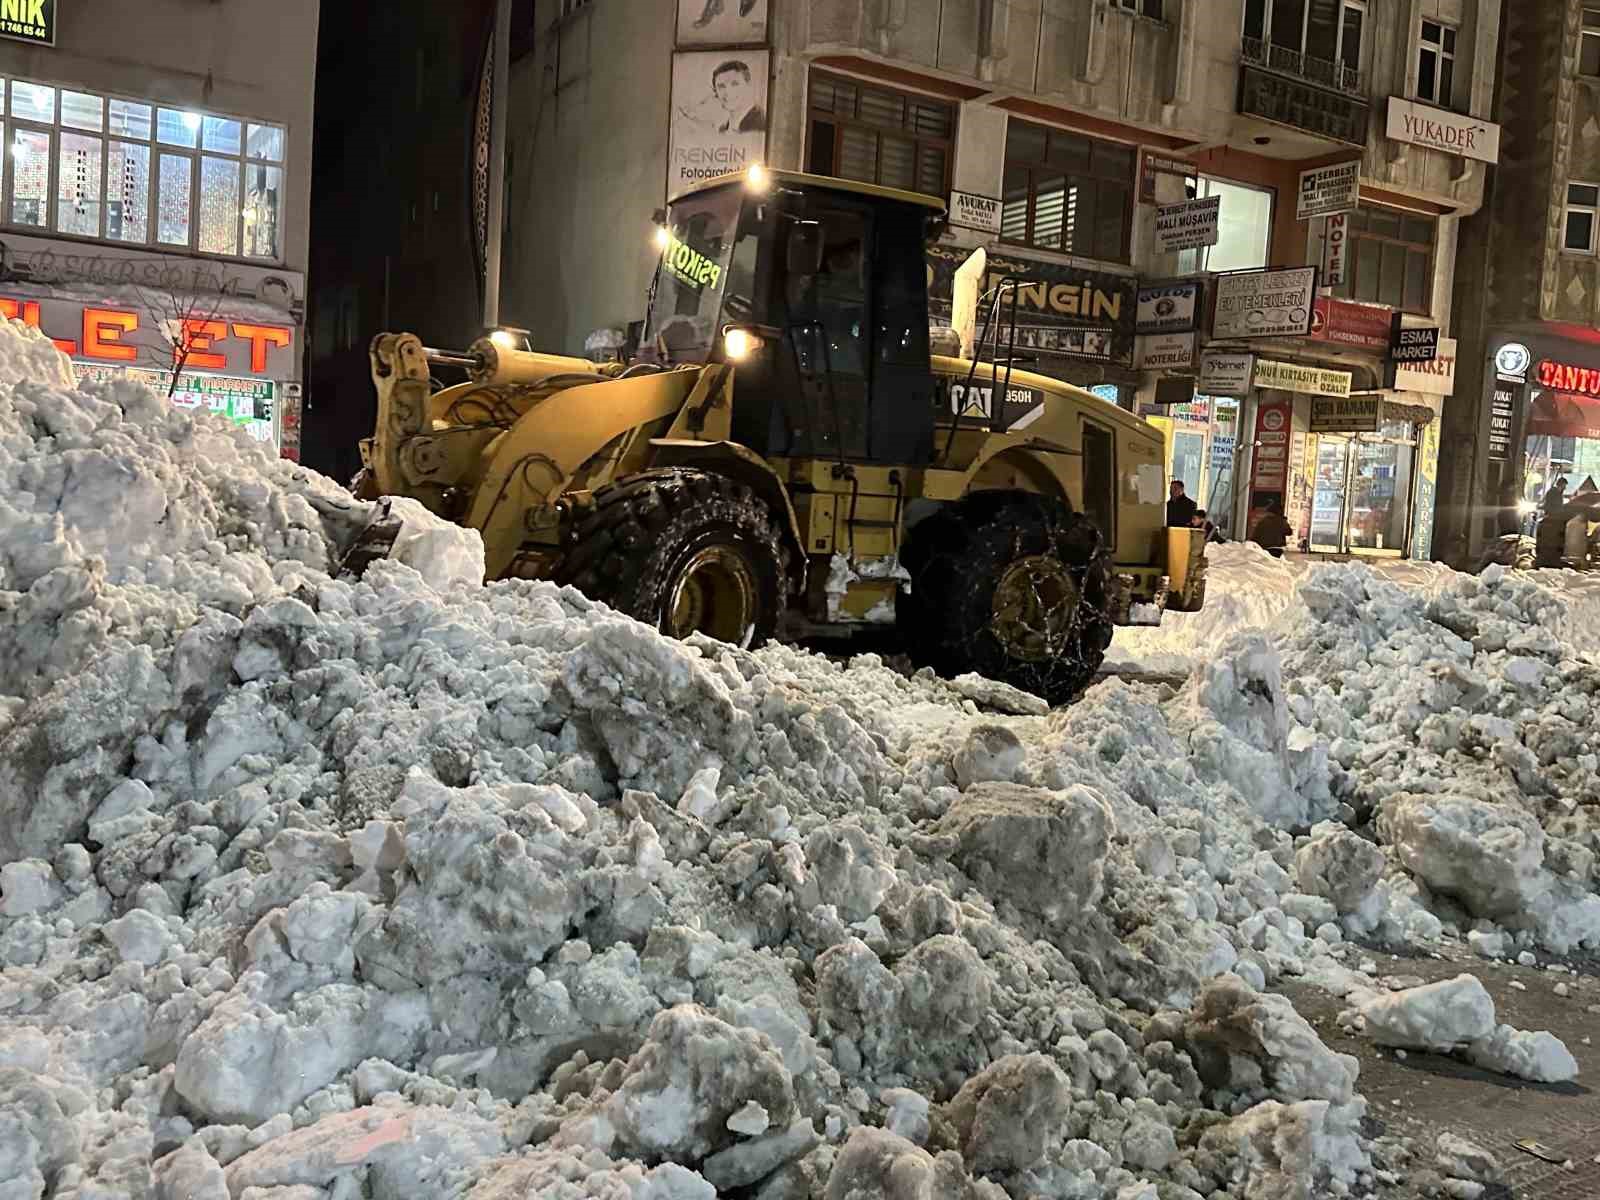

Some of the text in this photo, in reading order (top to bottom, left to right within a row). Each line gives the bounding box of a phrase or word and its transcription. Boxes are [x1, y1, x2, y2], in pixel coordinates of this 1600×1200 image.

[1404, 114, 1475, 150] YUKADER
[957, 195, 998, 213] AVUKAT
[1329, 214, 1344, 286] NOTER
[174, 318, 291, 373] ET
[1392, 345, 1435, 359] MARKET
[1400, 330, 1433, 345] ESMA
[951, 384, 992, 419] CAT
